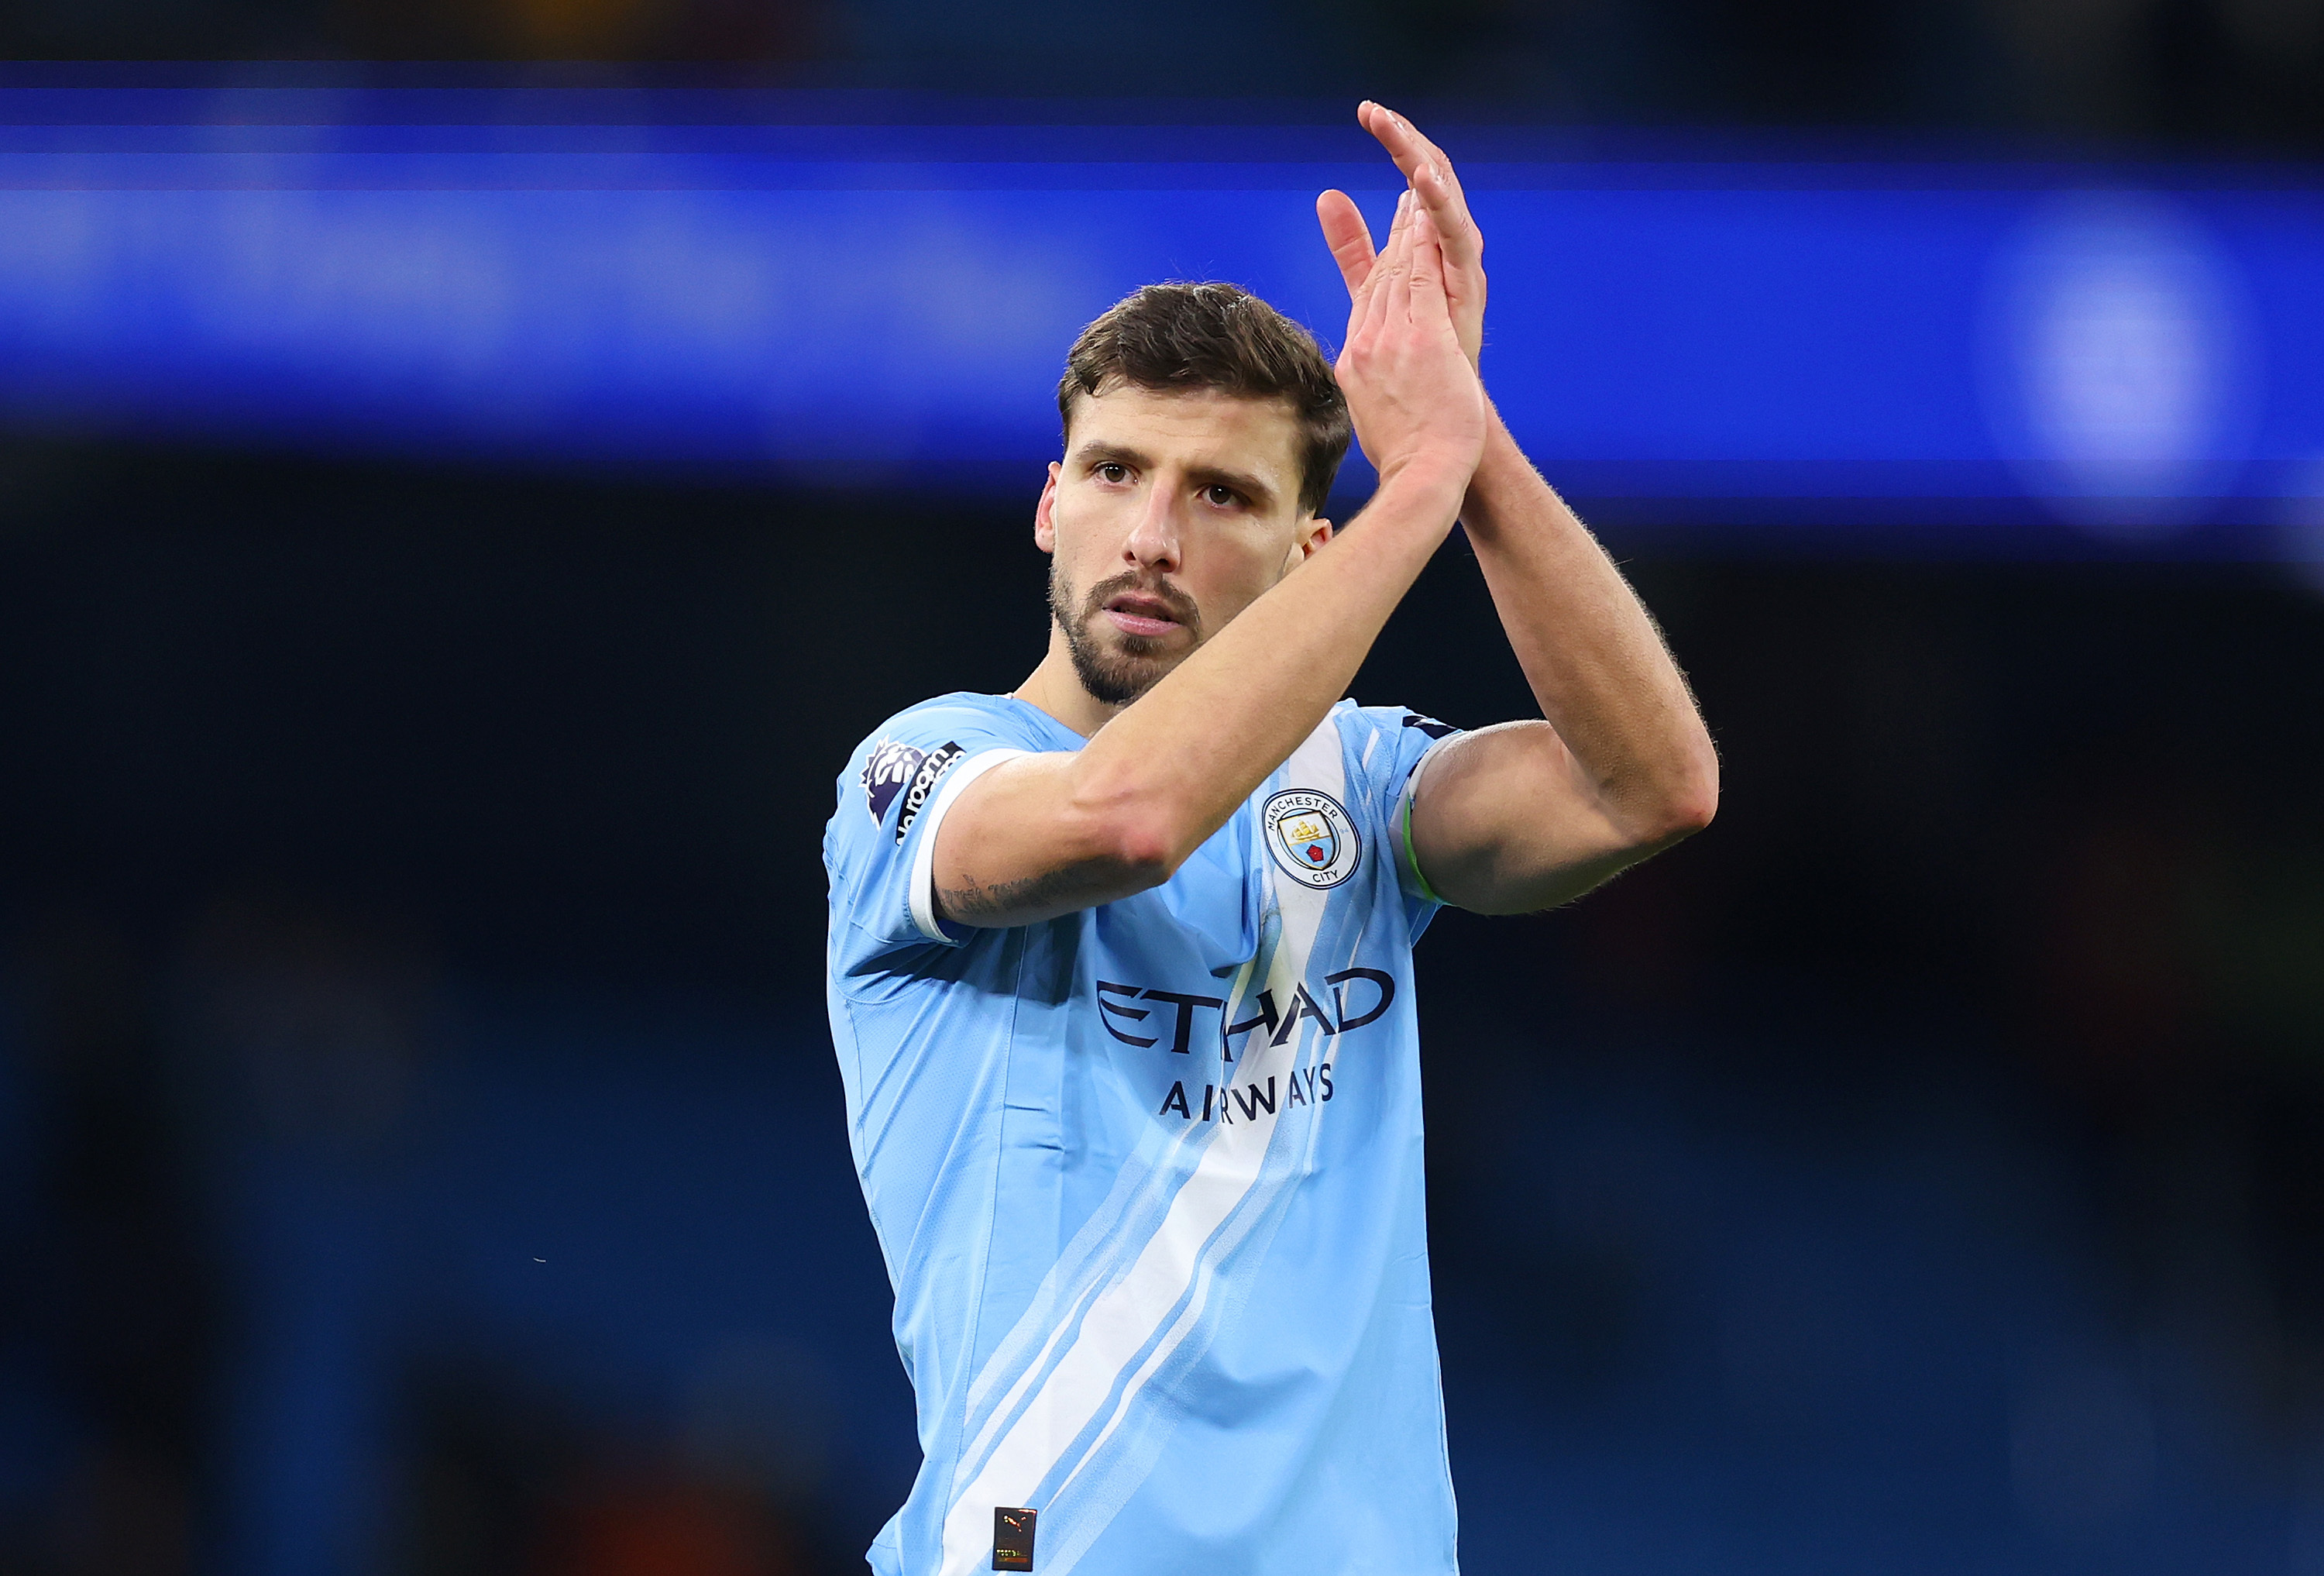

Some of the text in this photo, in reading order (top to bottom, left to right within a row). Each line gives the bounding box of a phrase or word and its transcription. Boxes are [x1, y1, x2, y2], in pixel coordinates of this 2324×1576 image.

[906, 748, 949, 813] room
[1268, 797, 1338, 831] MANCHESTER
[1312, 869, 1339, 883] CITY
[1159, 1063, 1333, 1124] AIRWAYS
